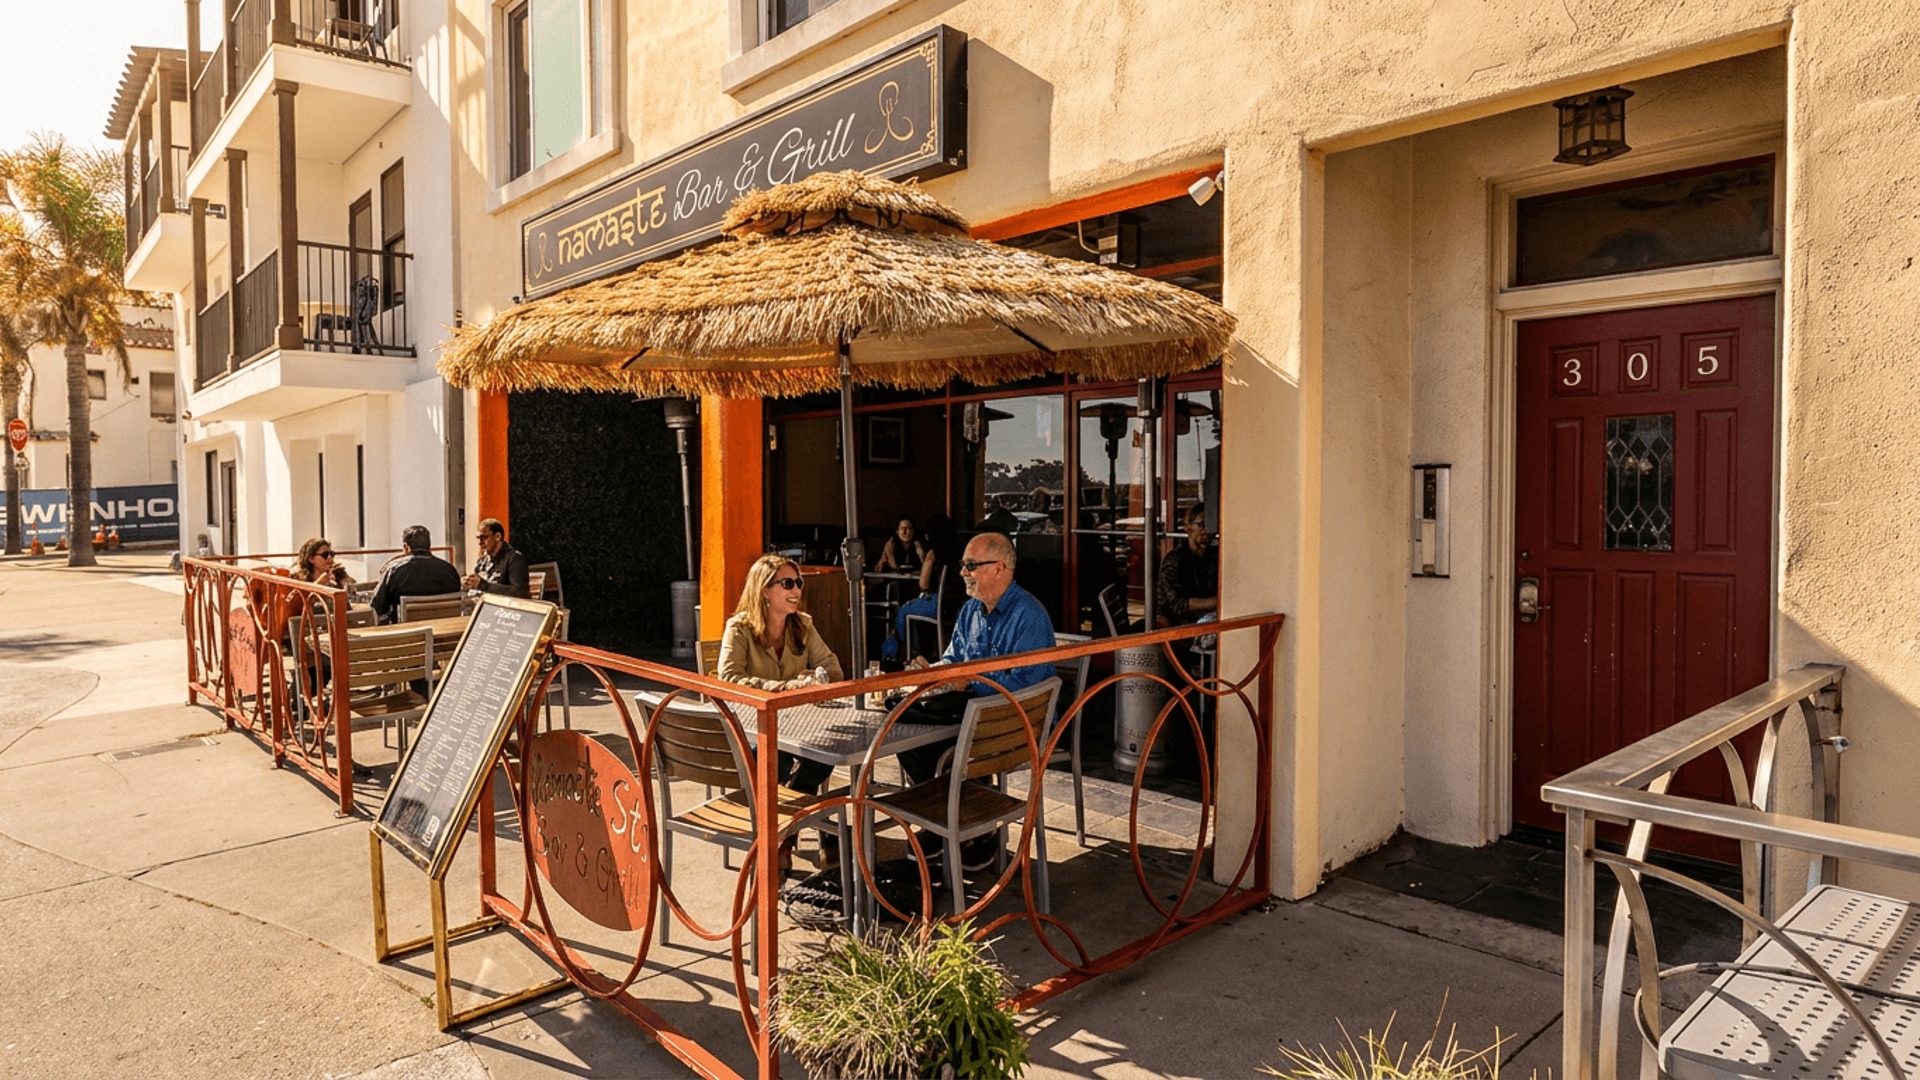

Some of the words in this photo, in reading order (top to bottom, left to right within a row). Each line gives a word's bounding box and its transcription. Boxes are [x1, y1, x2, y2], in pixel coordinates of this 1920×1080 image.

[673, 169, 728, 221] Bar
[734, 142, 764, 197] &
[767, 113, 856, 186] Grill
